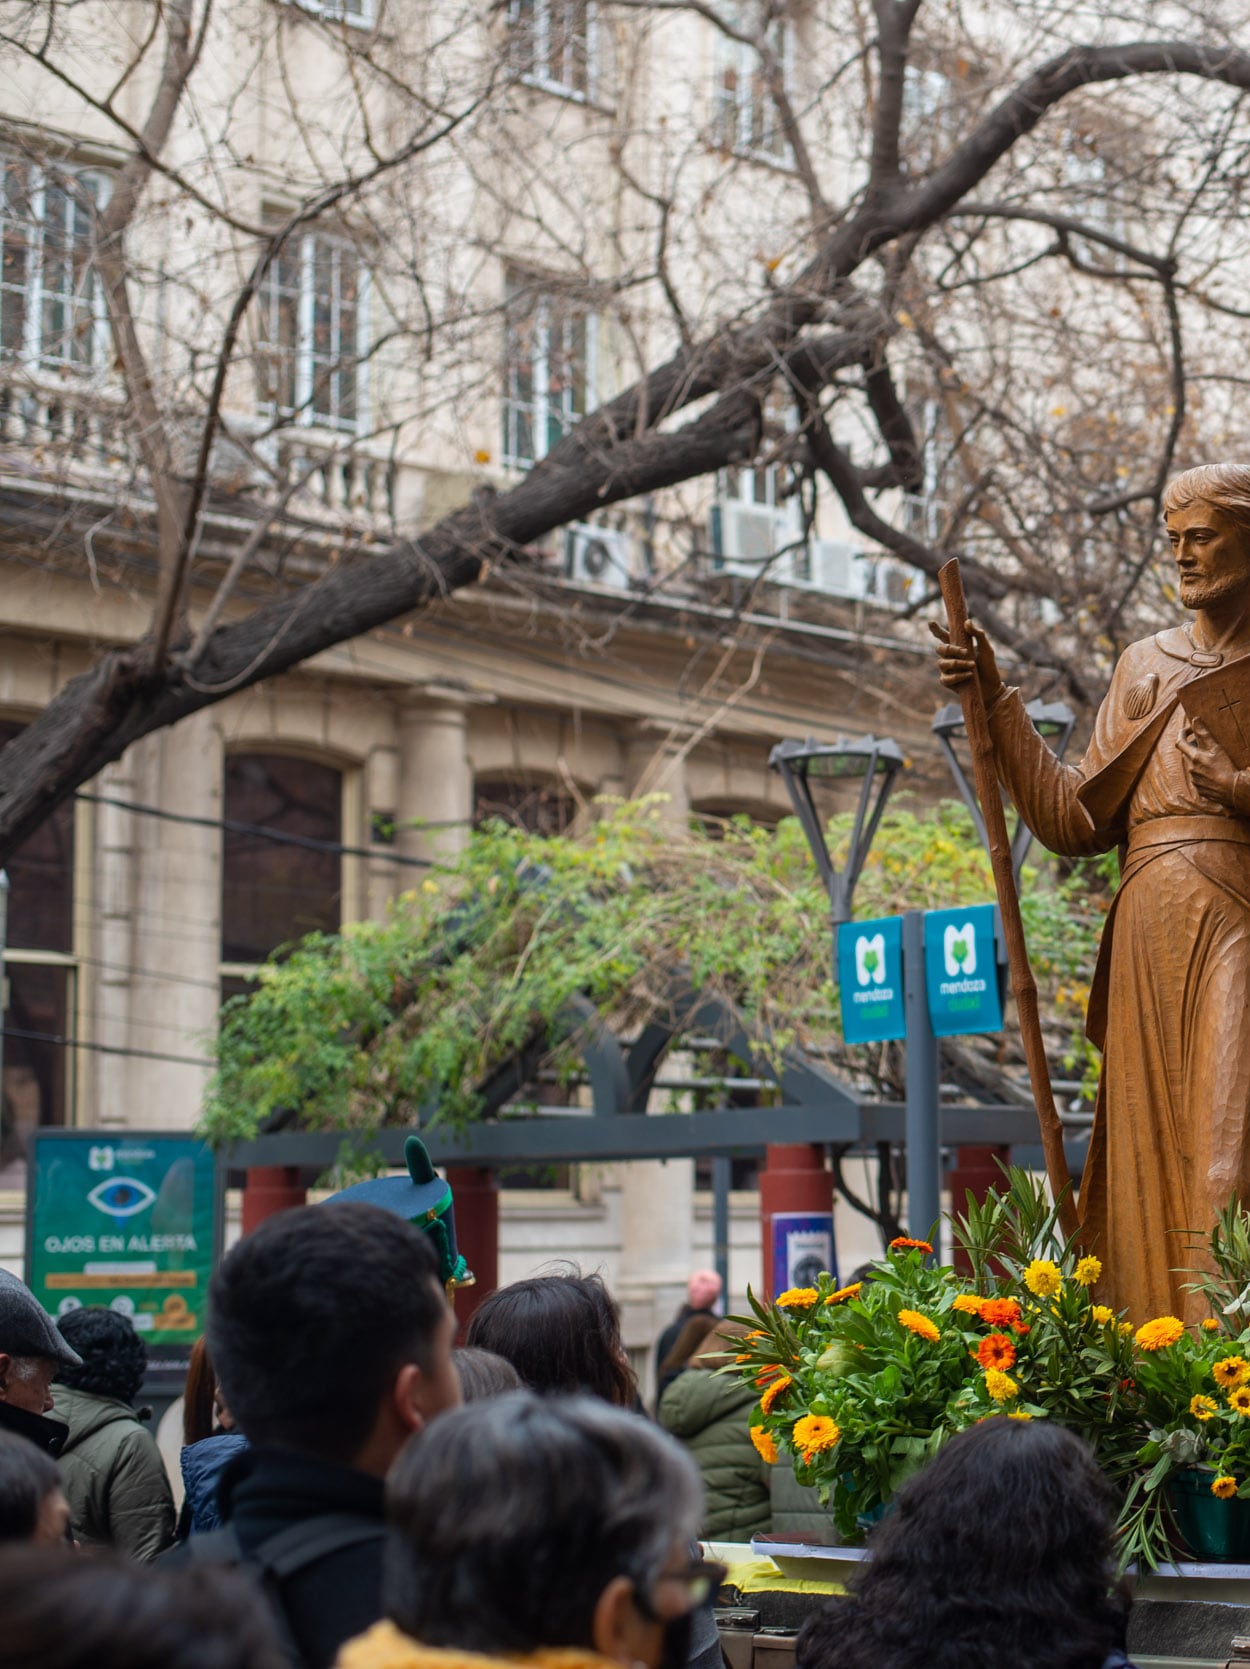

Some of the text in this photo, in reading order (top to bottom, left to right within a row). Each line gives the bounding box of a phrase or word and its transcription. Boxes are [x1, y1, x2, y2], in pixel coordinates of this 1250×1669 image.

[940, 979, 986, 994] mendoza
[853, 988, 893, 1003] mendoza
[45, 1233, 197, 1253] OJOS EN ALERTA
